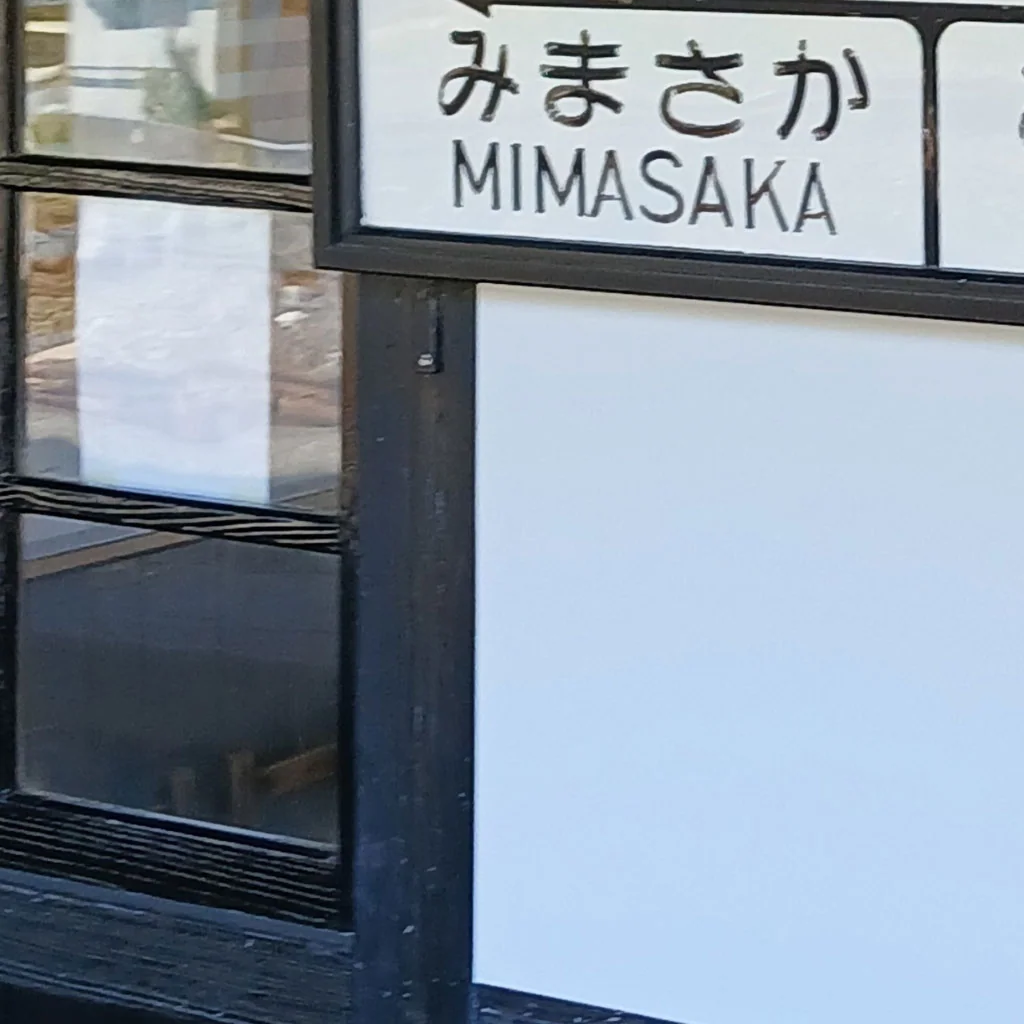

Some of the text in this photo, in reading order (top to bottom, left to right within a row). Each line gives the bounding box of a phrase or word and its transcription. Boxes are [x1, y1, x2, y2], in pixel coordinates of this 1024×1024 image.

[438, 29, 871, 142] みまさか
[452, 139, 838, 236] MIMASAKA
